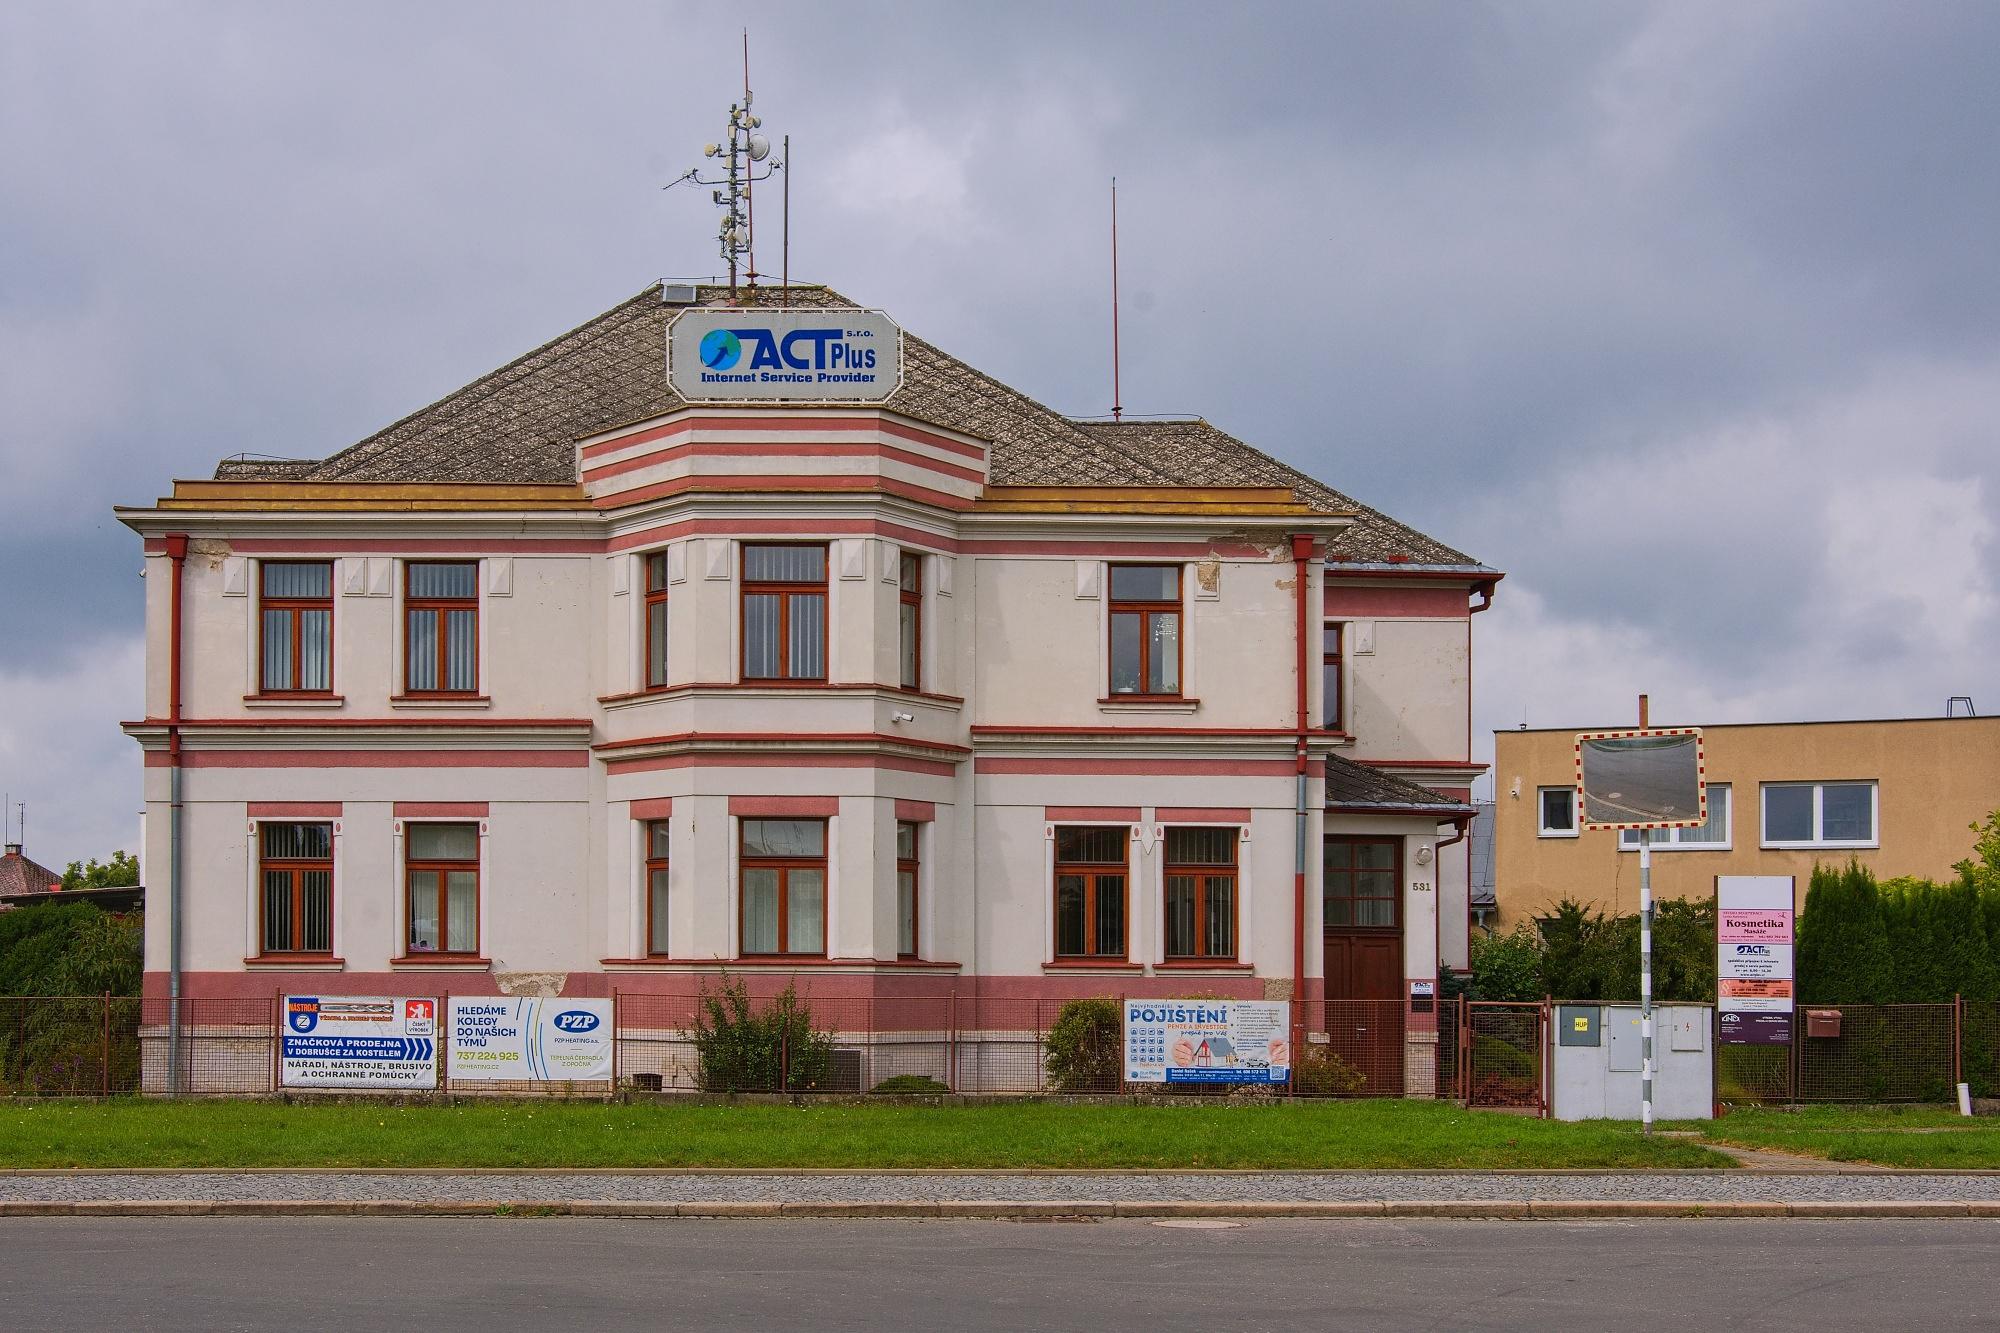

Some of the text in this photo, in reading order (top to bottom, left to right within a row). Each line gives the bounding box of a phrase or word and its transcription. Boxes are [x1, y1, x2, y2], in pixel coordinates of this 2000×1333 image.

[737, 329, 876, 370] ACT Plus
[701, 373, 876, 382] Internet Service Provider
[1412, 883, 1431, 891] 531
[1726, 919, 1784, 928] Kosmetika
[1745, 945, 1764, 953] ACT
[457, 1005, 507, 1015] HLEDÁME
[1130, 1004, 1228, 1023] POJIŠTĚNÍ
[457, 1018, 498, 1026] KOLEGY
[559, 1015, 596, 1029] PZP
[457, 1027, 516, 1037] DO NAŠICH
[288, 1037, 401, 1048] ZNAČKOVÁ PRODEJNA
[457, 1037, 487, 1047] TÝMŮ
[295, 1048, 341, 1056] DOBRUŠCE
[457, 1052, 519, 1060] 737 224 925
[288, 1060, 328, 1070] NÁŘADÍ,
[331, 1061, 386, 1070] NÁSTROJE,
[311, 1070, 366, 1079] OCHRANNÉ
[369, 1071, 419, 1079] POMŮCKY
